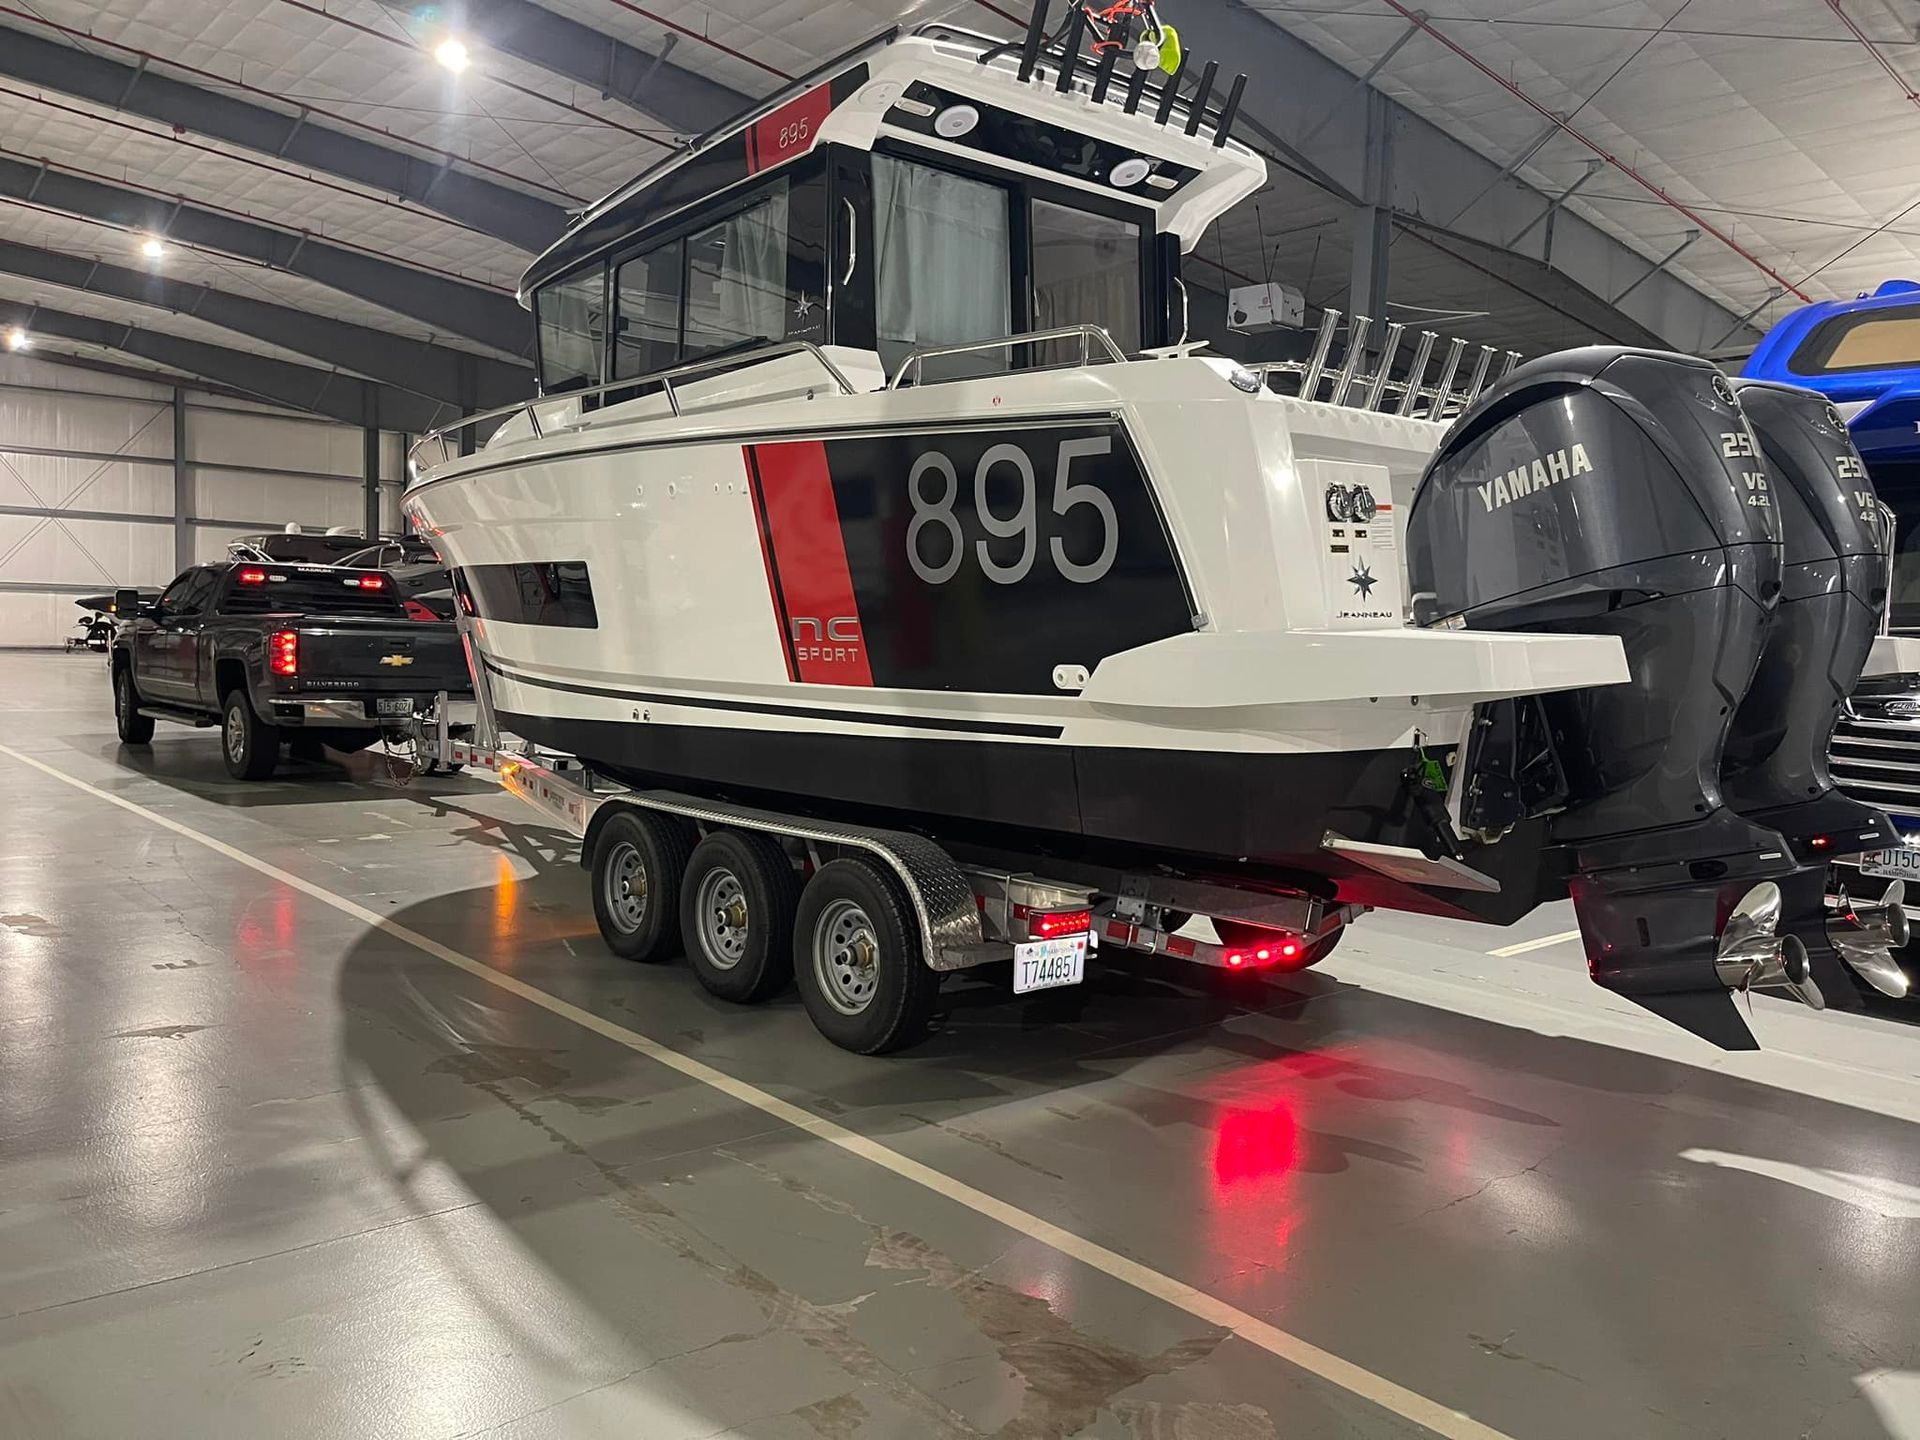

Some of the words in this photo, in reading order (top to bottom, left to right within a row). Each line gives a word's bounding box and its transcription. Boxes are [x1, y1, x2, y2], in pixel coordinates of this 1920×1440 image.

[779, 116, 808, 149] 895
[1477, 443, 1593, 513] YAMAHA
[1742, 472, 1767, 491] V6
[906, 435, 1118, 584] 895
[1854, 491, 1875, 508] V6
[1336, 610, 1392, 619] JEANNEAU
[799, 647, 858, 662] SPORT
[1023, 954, 1077, 984] T744851
